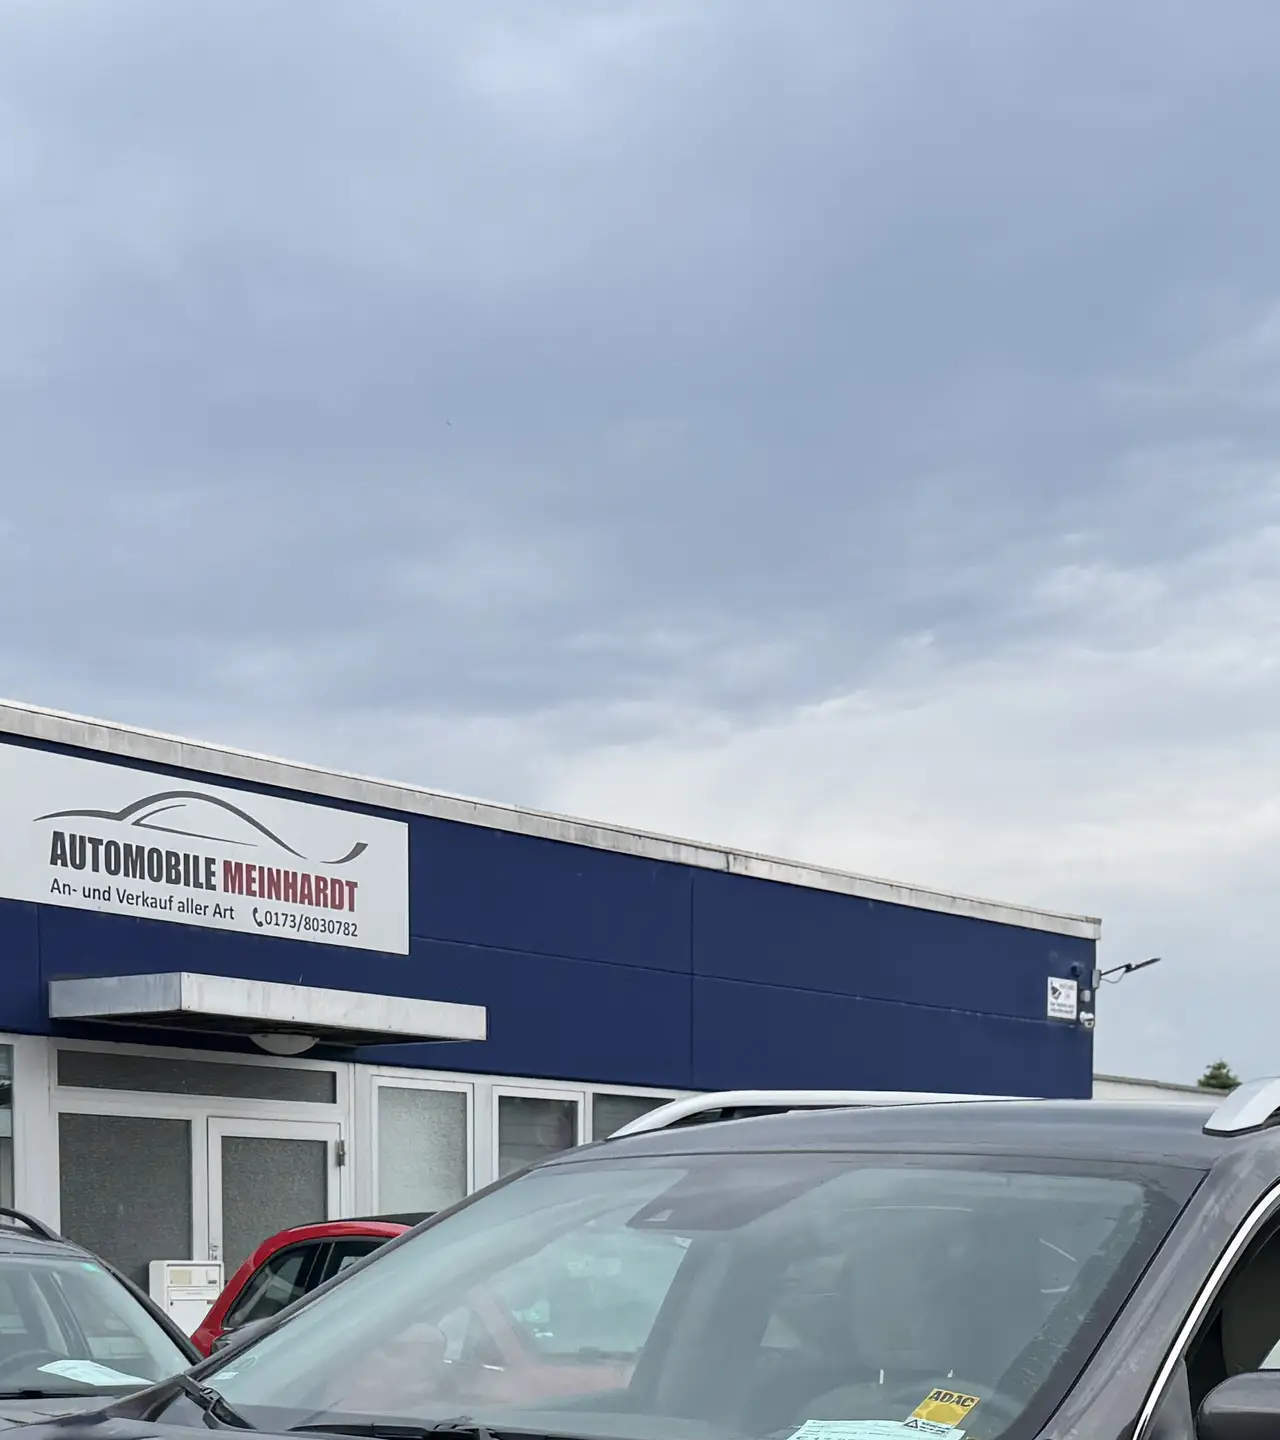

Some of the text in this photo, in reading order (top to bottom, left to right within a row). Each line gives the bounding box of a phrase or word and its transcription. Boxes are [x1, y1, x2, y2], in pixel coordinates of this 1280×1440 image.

[50, 830, 359, 912] AUTOMOBILE MEINHARDT
[50, 877, 359, 937] An- und Verkauf aller Art 0173/8030782
[928, 1390, 975, 1408] ADAC
